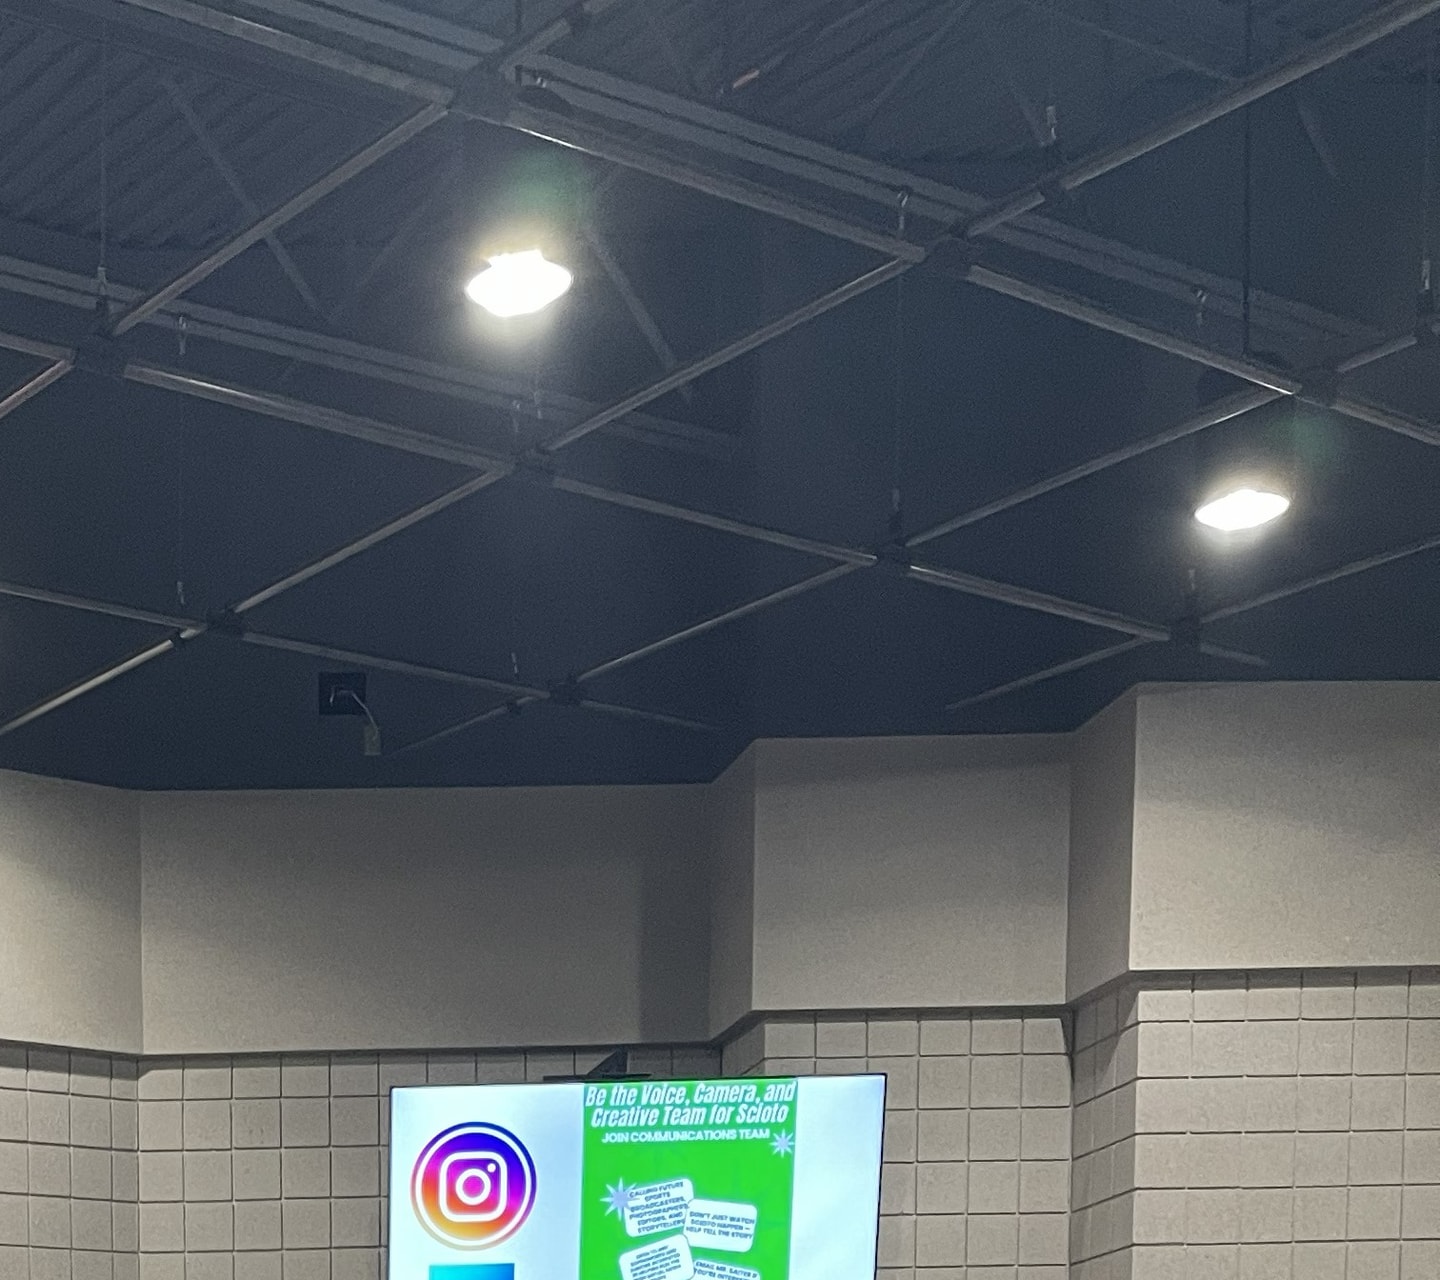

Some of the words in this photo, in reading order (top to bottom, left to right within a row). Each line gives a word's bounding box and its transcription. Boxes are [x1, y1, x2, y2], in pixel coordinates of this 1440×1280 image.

[585, 1085, 607, 1106] Be
[611, 1084, 637, 1106] the
[640, 1084, 690, 1106] Voice,
[694, 1082, 760, 1104] Camera,
[763, 1080, 797, 1103] and
[591, 1106, 659, 1128] Creative
[662, 1105, 706, 1126] Team
[709, 1104, 735, 1125] for
[736, 1103, 790, 1124] Scioto
[602, 1132, 629, 1144] JOIN
[630, 1130, 737, 1143] COMMUNICATIONS
[739, 1128, 770, 1140] TEAM
